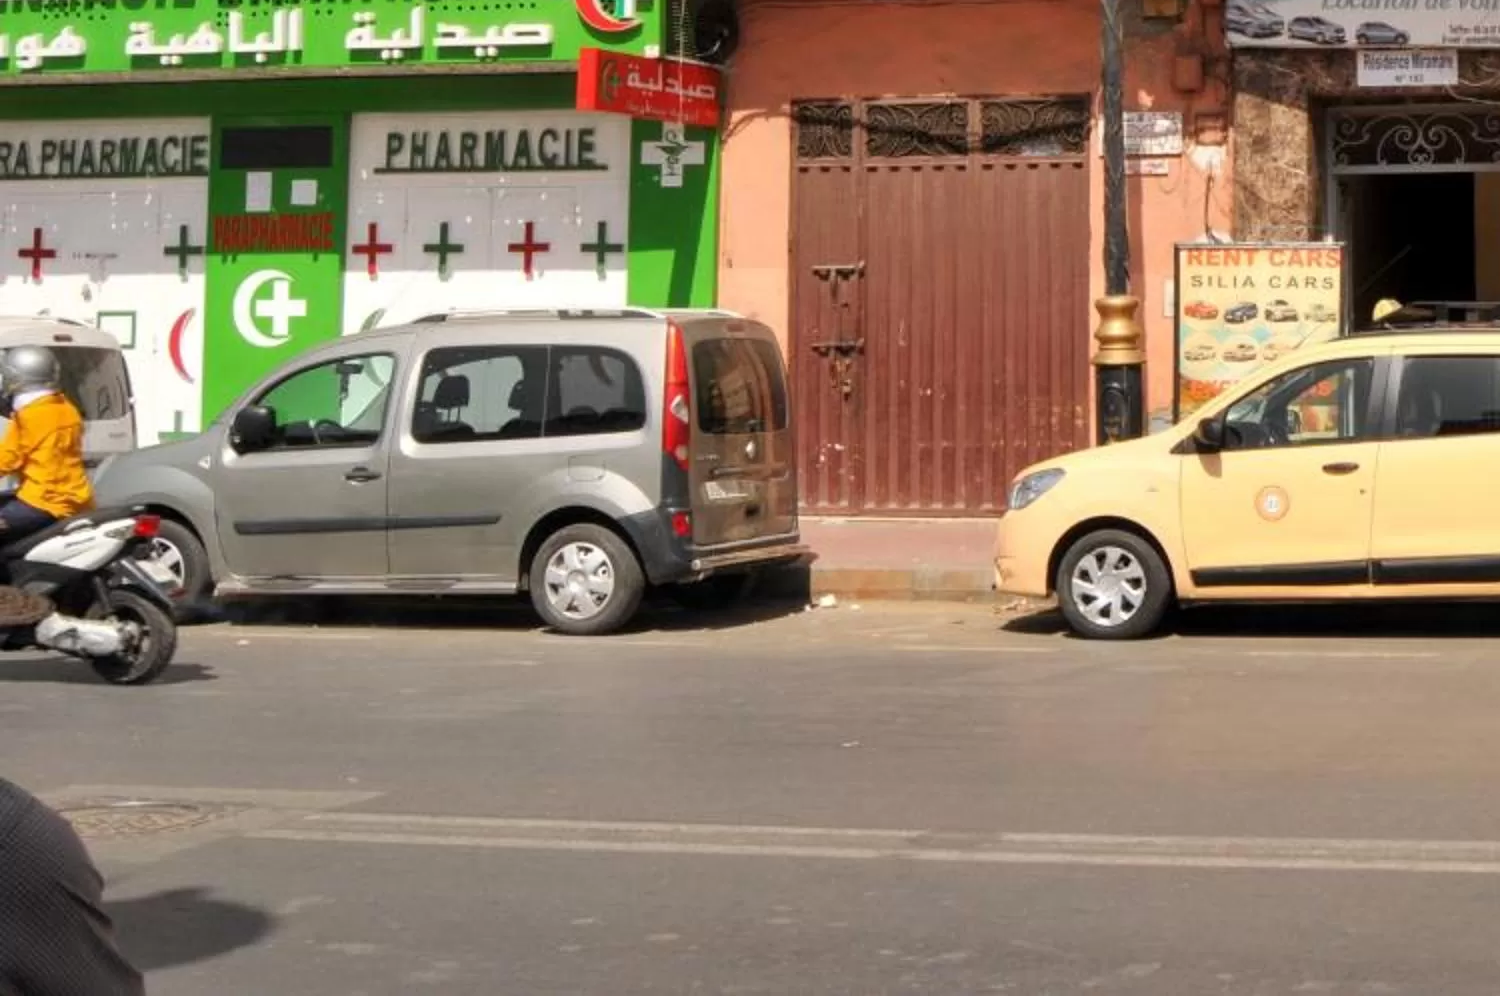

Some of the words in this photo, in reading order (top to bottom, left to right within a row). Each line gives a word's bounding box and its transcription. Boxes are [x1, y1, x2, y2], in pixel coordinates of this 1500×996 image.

[124, 7, 304, 66] الباهية
[345, 4, 555, 62] صيدلية
[41, 134, 209, 176] PHARMACIE
[385, 127, 597, 171] PHARMACIE
[1187, 250, 1256, 267] RENT
[1268, 250, 1341, 268] CARS
[1190, 275, 1256, 290] SILIA
[1268, 275, 1335, 290] CARS
